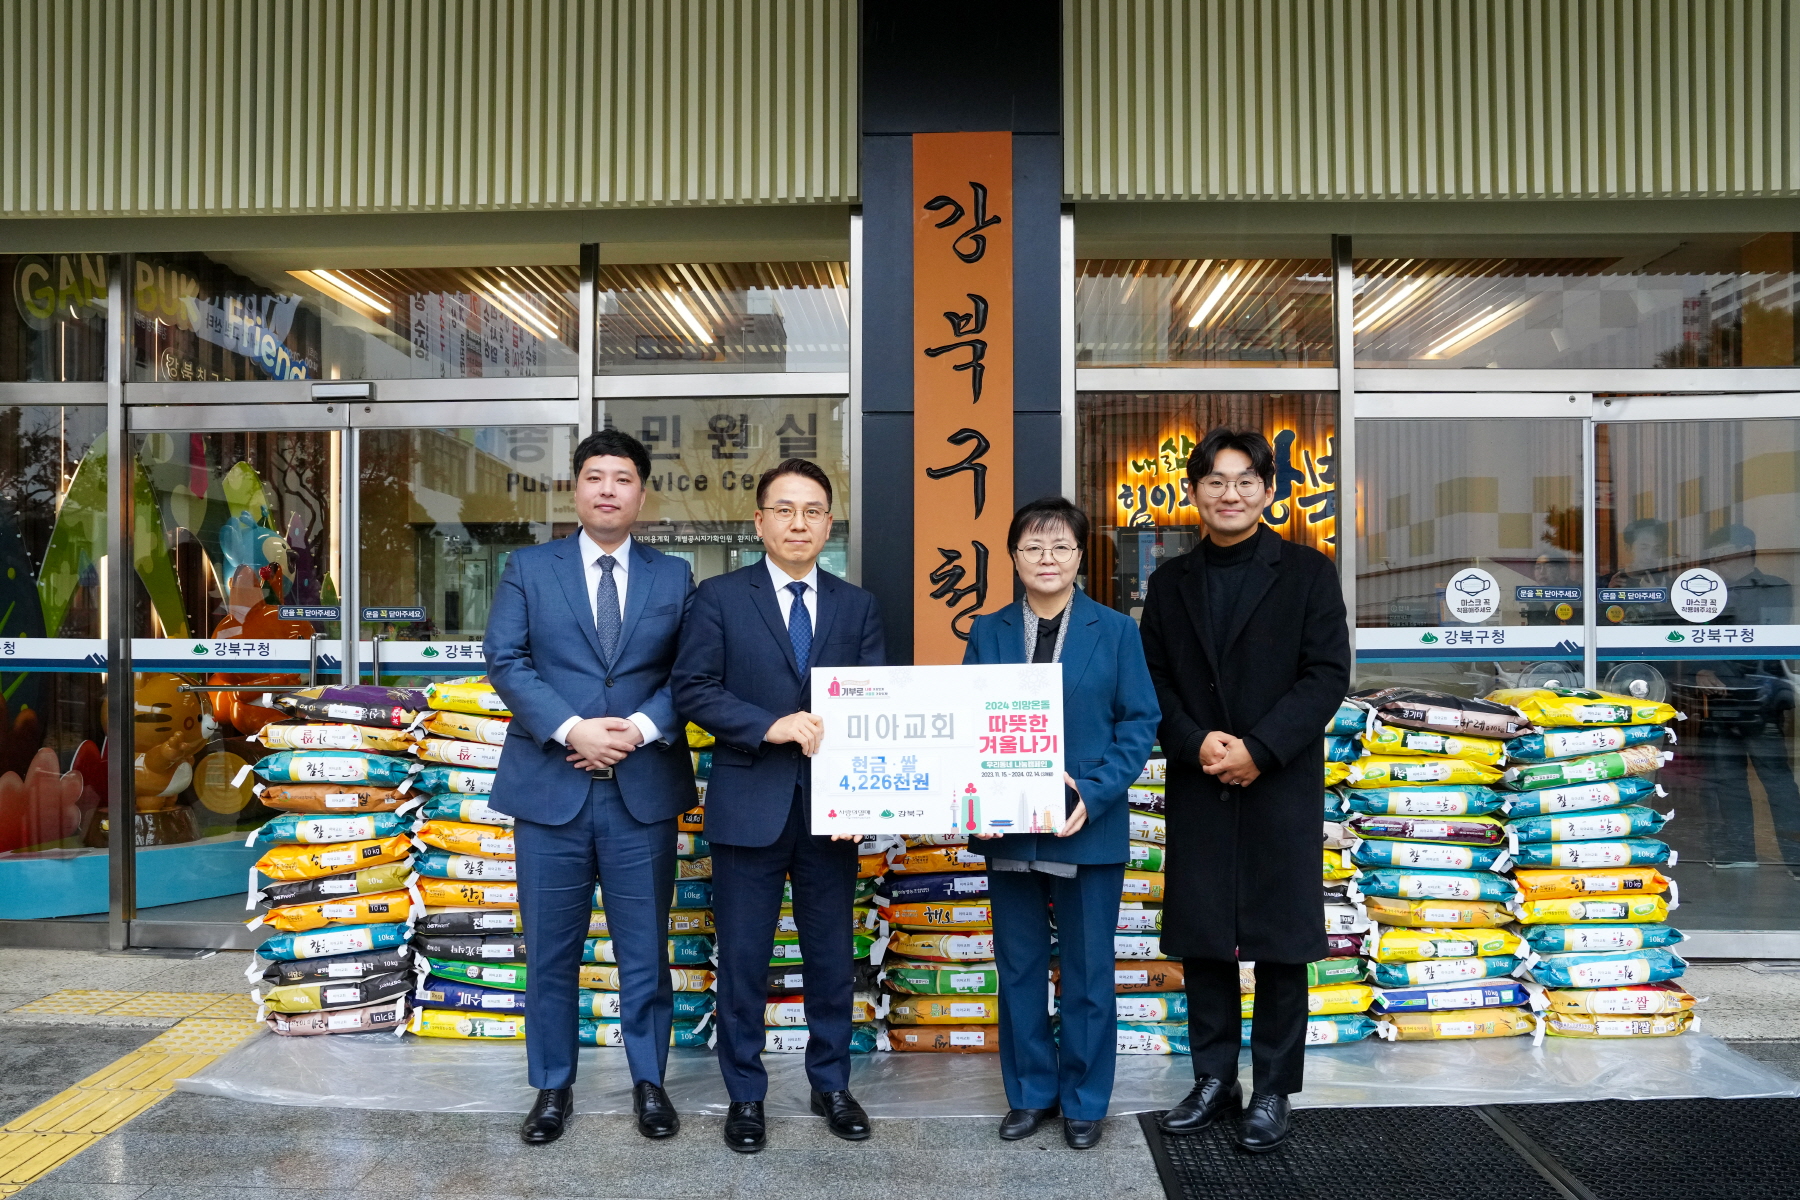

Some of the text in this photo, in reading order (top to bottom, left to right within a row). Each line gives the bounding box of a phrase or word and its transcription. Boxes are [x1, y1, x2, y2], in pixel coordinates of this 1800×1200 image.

[923, 181, 1001, 641] 강북구청
[1520, 590, 1579, 598] 문을 꼭 닫아주세요
[1602, 592, 1662, 600] 문을 꼭 닫아주세요
[1461, 599, 1481, 607] 마스크
[1686, 599, 1717, 607] 마스크 꼭
[282, 609, 295, 617] 문을
[366, 610, 421, 618] 문을 꼭 닫아주세요
[1444, 629, 1505, 645] 강북구청
[1691, 628, 1754, 643] 강북구청
[214, 641, 270, 657] 강북구청
[842, 687, 864, 696] 기부로
[985, 700, 1050, 711] 2024 희망온돌
[847, 713, 955, 741] 미아교회
[988, 714, 1049, 733] 따뜻한
[979, 735, 1058, 754] 겨울나기
[851, 755, 918, 774] 현금 쌀
[839, 772, 929, 792] 4,226천원
[898, 810, 924, 818] 강북구
[1492, 960, 1508, 968] 10kg
[1635, 996, 1649, 1010] 쌀
